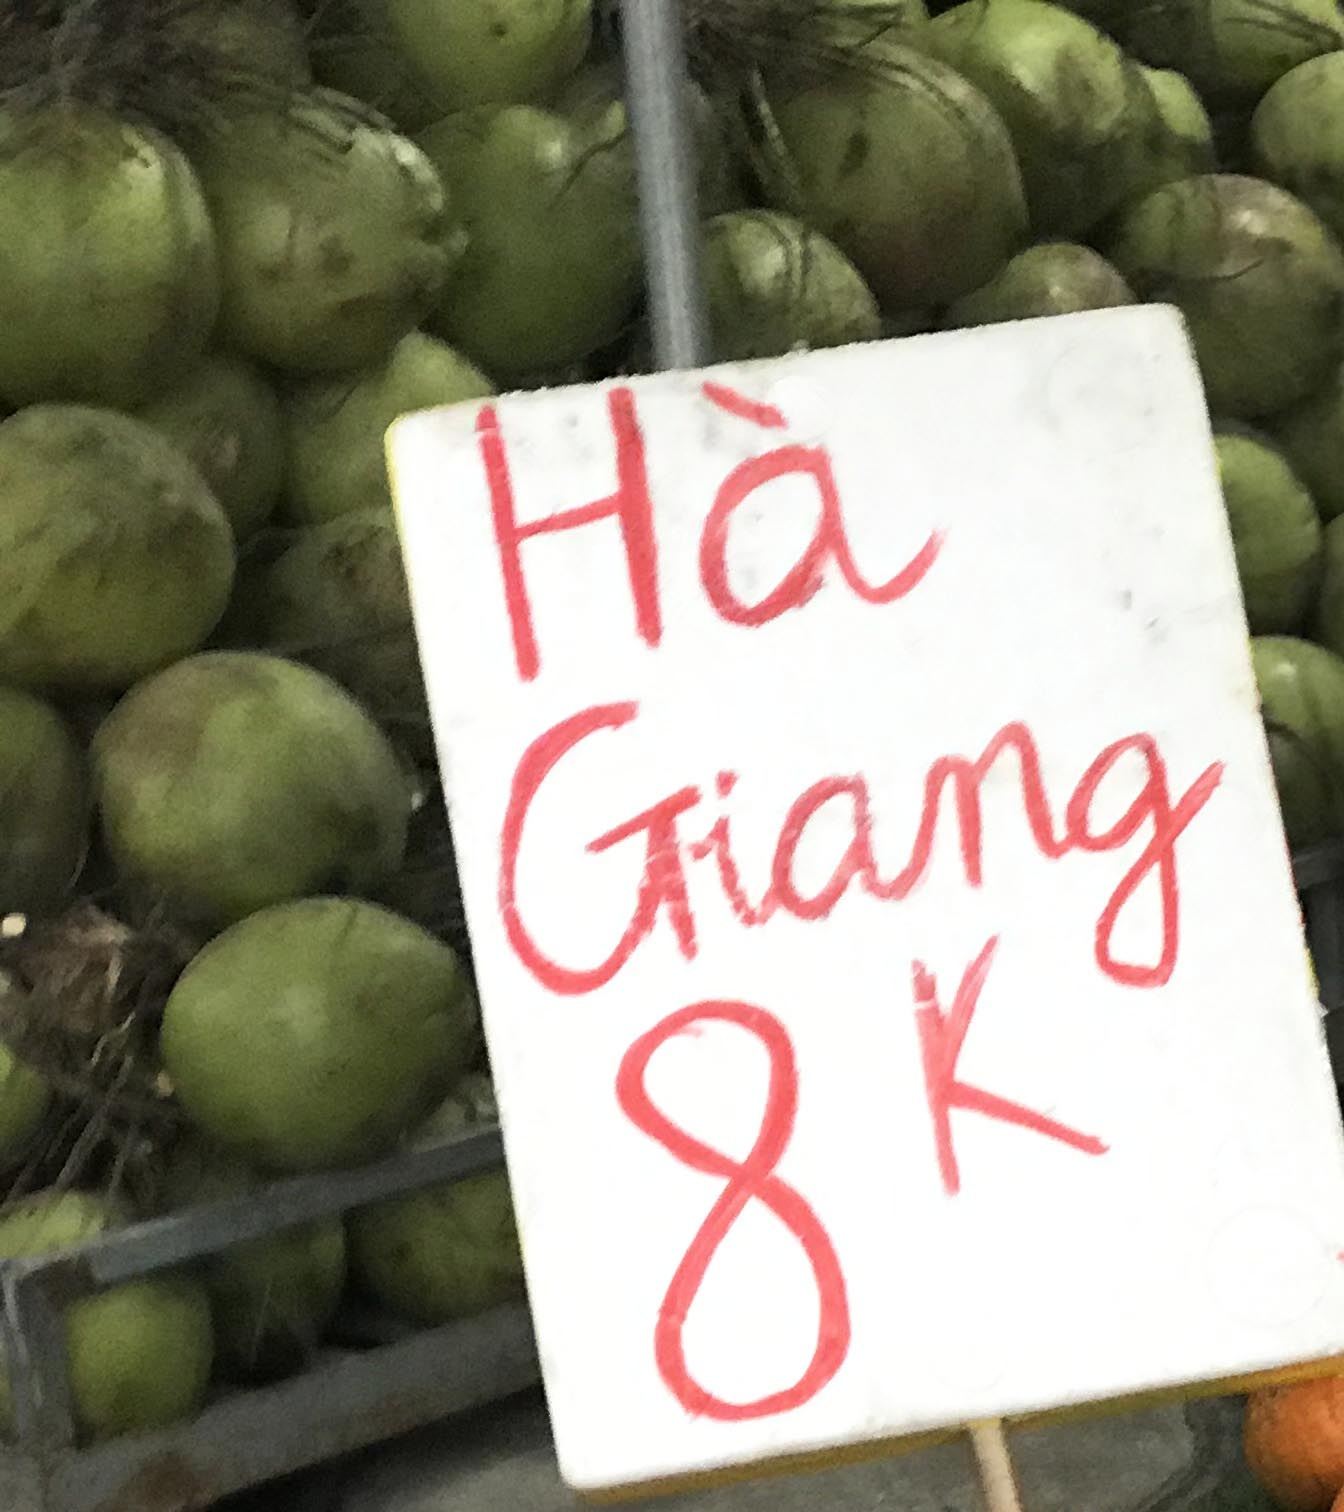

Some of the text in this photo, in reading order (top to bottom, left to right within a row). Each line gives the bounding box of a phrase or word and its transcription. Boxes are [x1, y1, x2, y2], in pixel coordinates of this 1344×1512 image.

[475, 380, 945, 681] Hà
[497, 700, 1226, 997] Giang
[615, 934, 1110, 1423] 8 K
